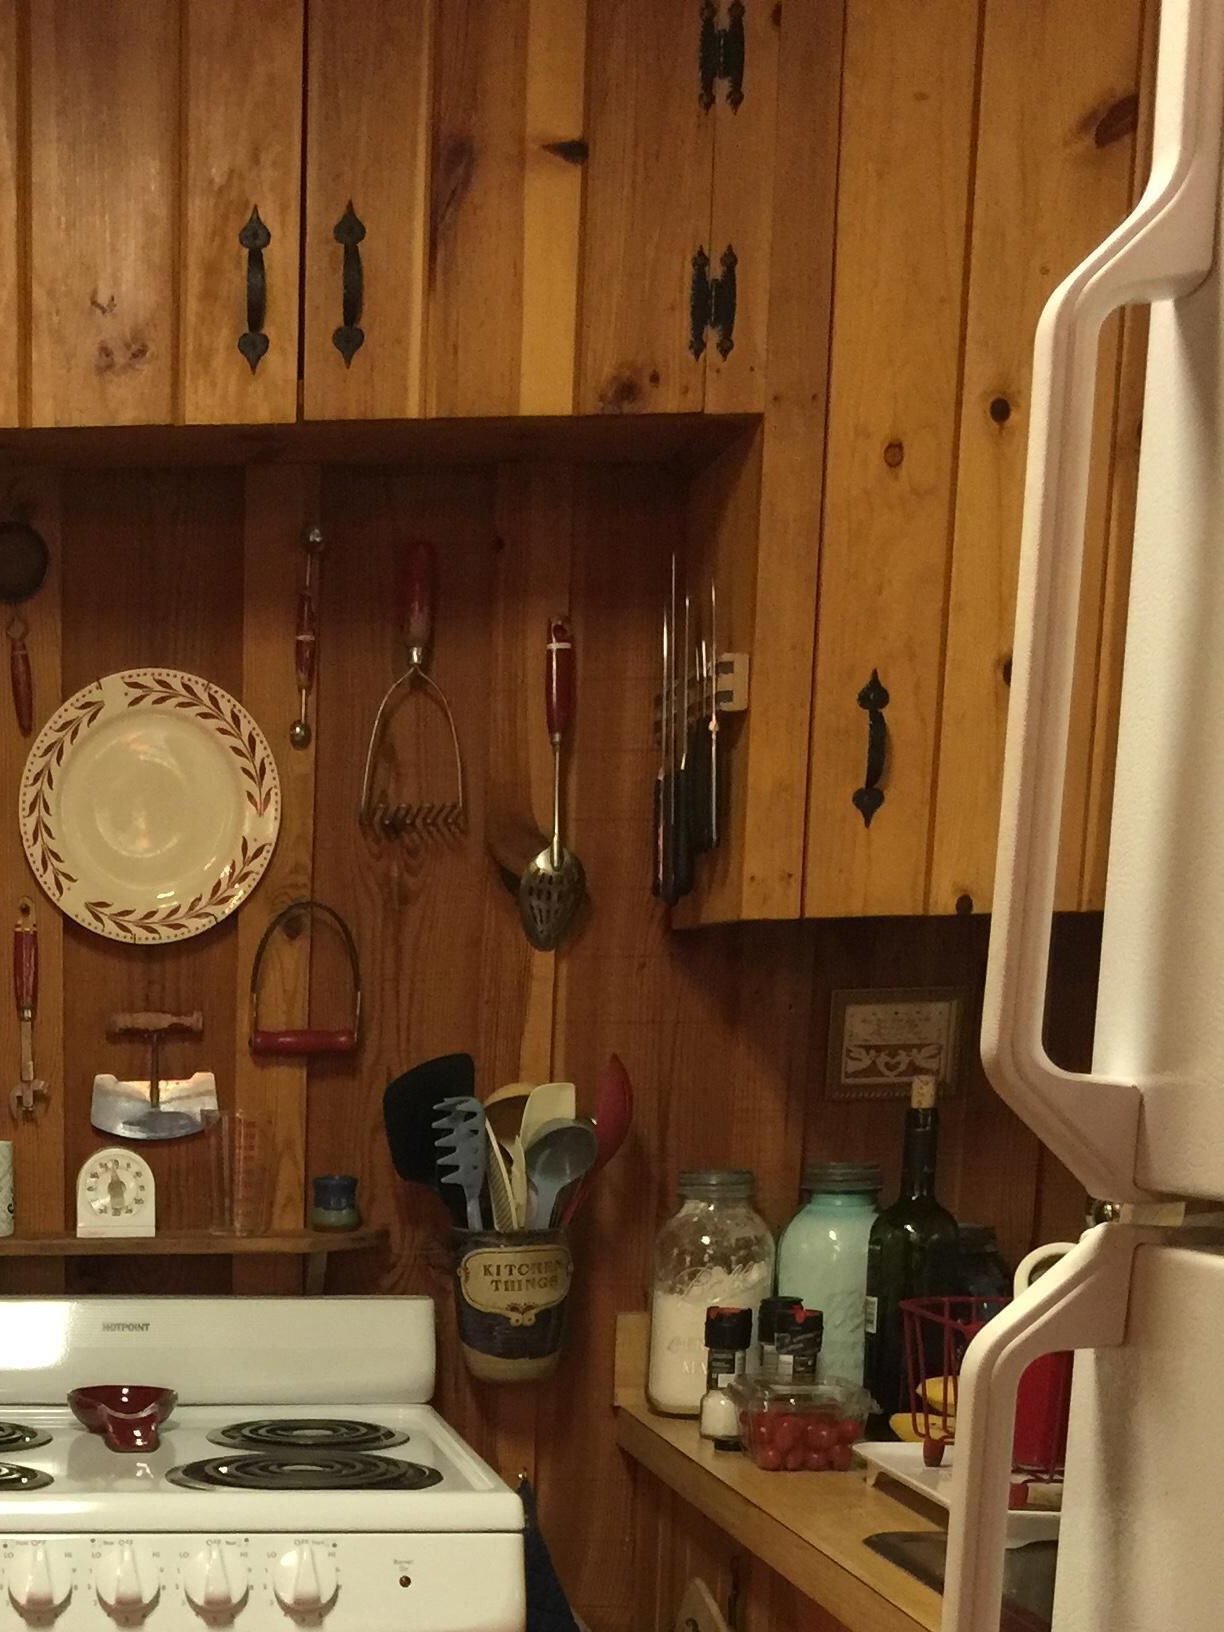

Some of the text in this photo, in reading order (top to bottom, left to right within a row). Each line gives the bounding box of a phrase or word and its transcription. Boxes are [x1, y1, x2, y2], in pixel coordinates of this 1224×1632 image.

[483, 1259, 561, 1277] KITCHEN
[490, 1275, 559, 1292] THINGS
[102, 1323, 150, 1332] HOTPOINT
[4, 1551, 15, 1559] LO
[91, 1551, 102, 1559] LO
